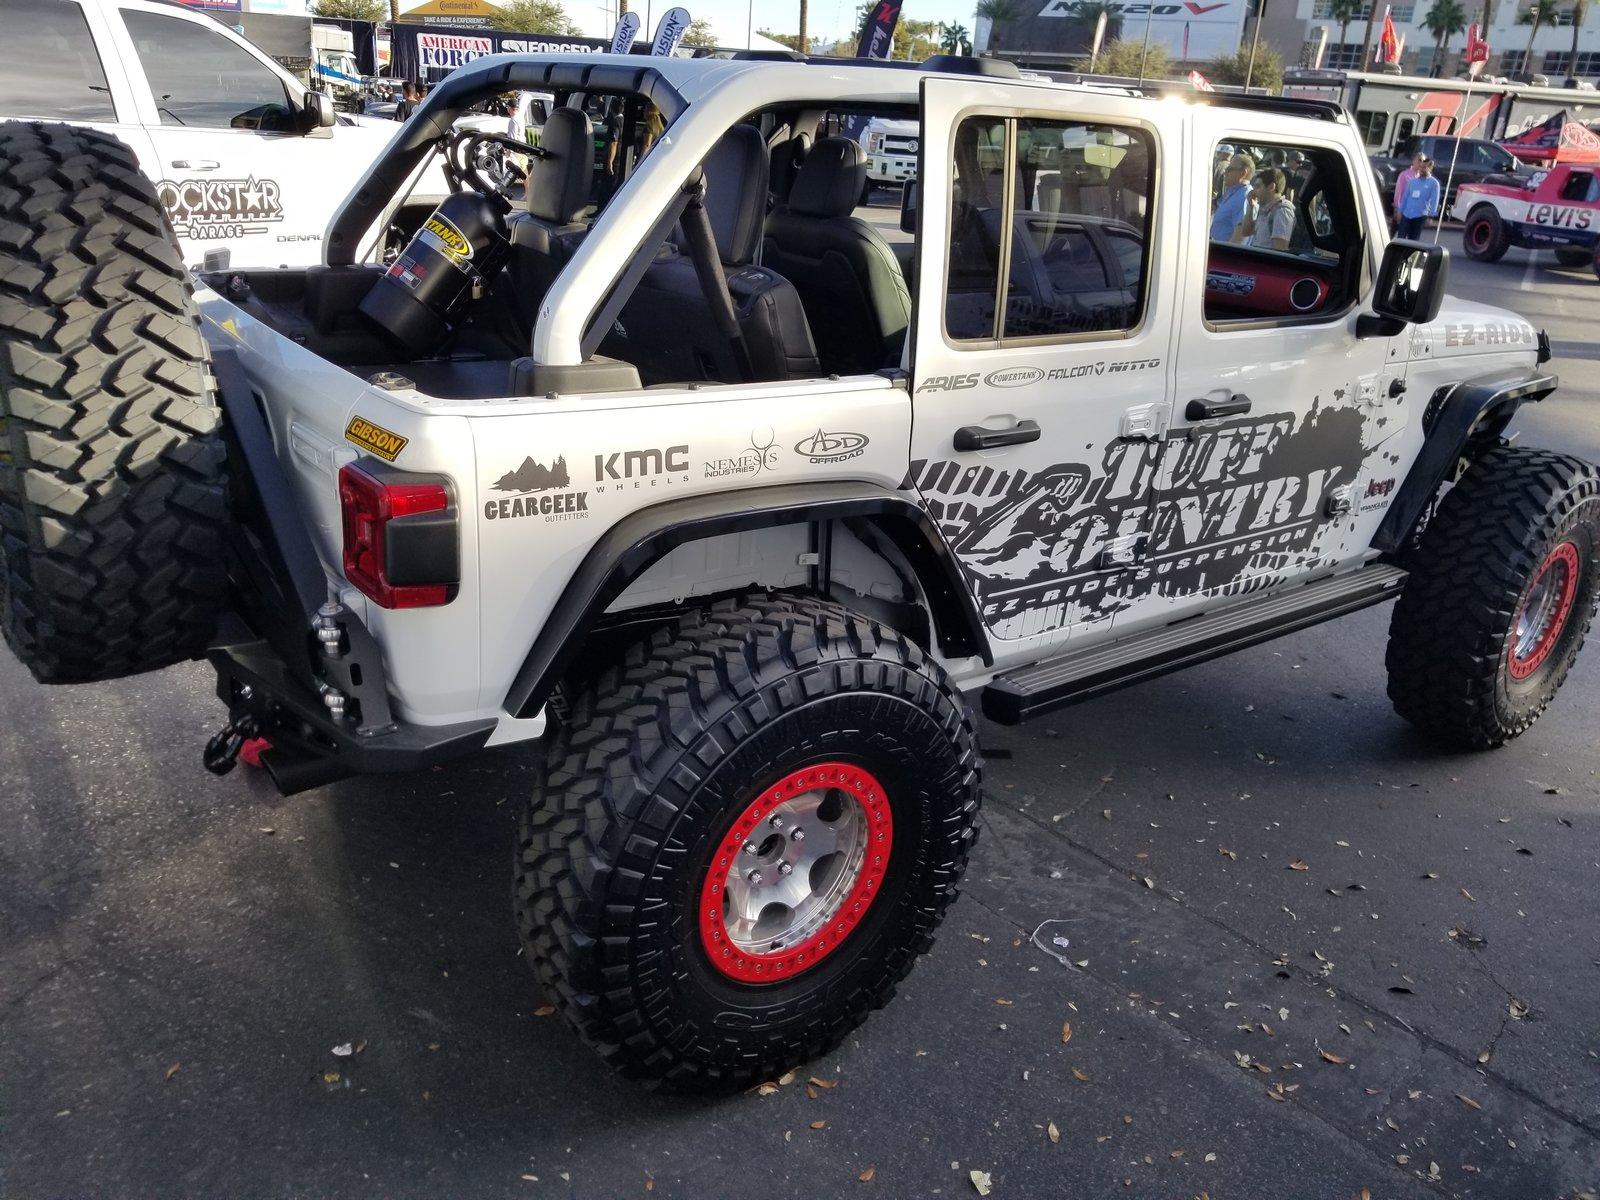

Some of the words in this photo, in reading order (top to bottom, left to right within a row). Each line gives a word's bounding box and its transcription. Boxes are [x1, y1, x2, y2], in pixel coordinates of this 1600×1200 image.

[421, 36, 490, 52] AMERICAN
[615, 21, 632, 54] USION
[155, 175, 282, 213] OCKSTAR
[189, 224, 245, 240] GARAGE
[276, 234, 324, 243] DENAL
[1107, 358, 1161, 373] NITTO
[915, 372, 981, 394] ARIES
[992, 371, 1038, 384] POWERTANK
[351, 420, 402, 453] GIBSON
[704, 451, 778, 472] NEMESIS
[809, 448, 865, 465] OFFROAD
[1104, 420, 1294, 500] TUFF
[704, 465, 755, 478] INDUSTRIES
[595, 475, 690, 494] WHEELS
[1364, 478, 1396, 499] Jeep
[484, 491, 588, 520] GEARGEEK
[545, 511, 589, 523] OUTFITTERS
[1135, 528, 1309, 580] SUSPENSION
